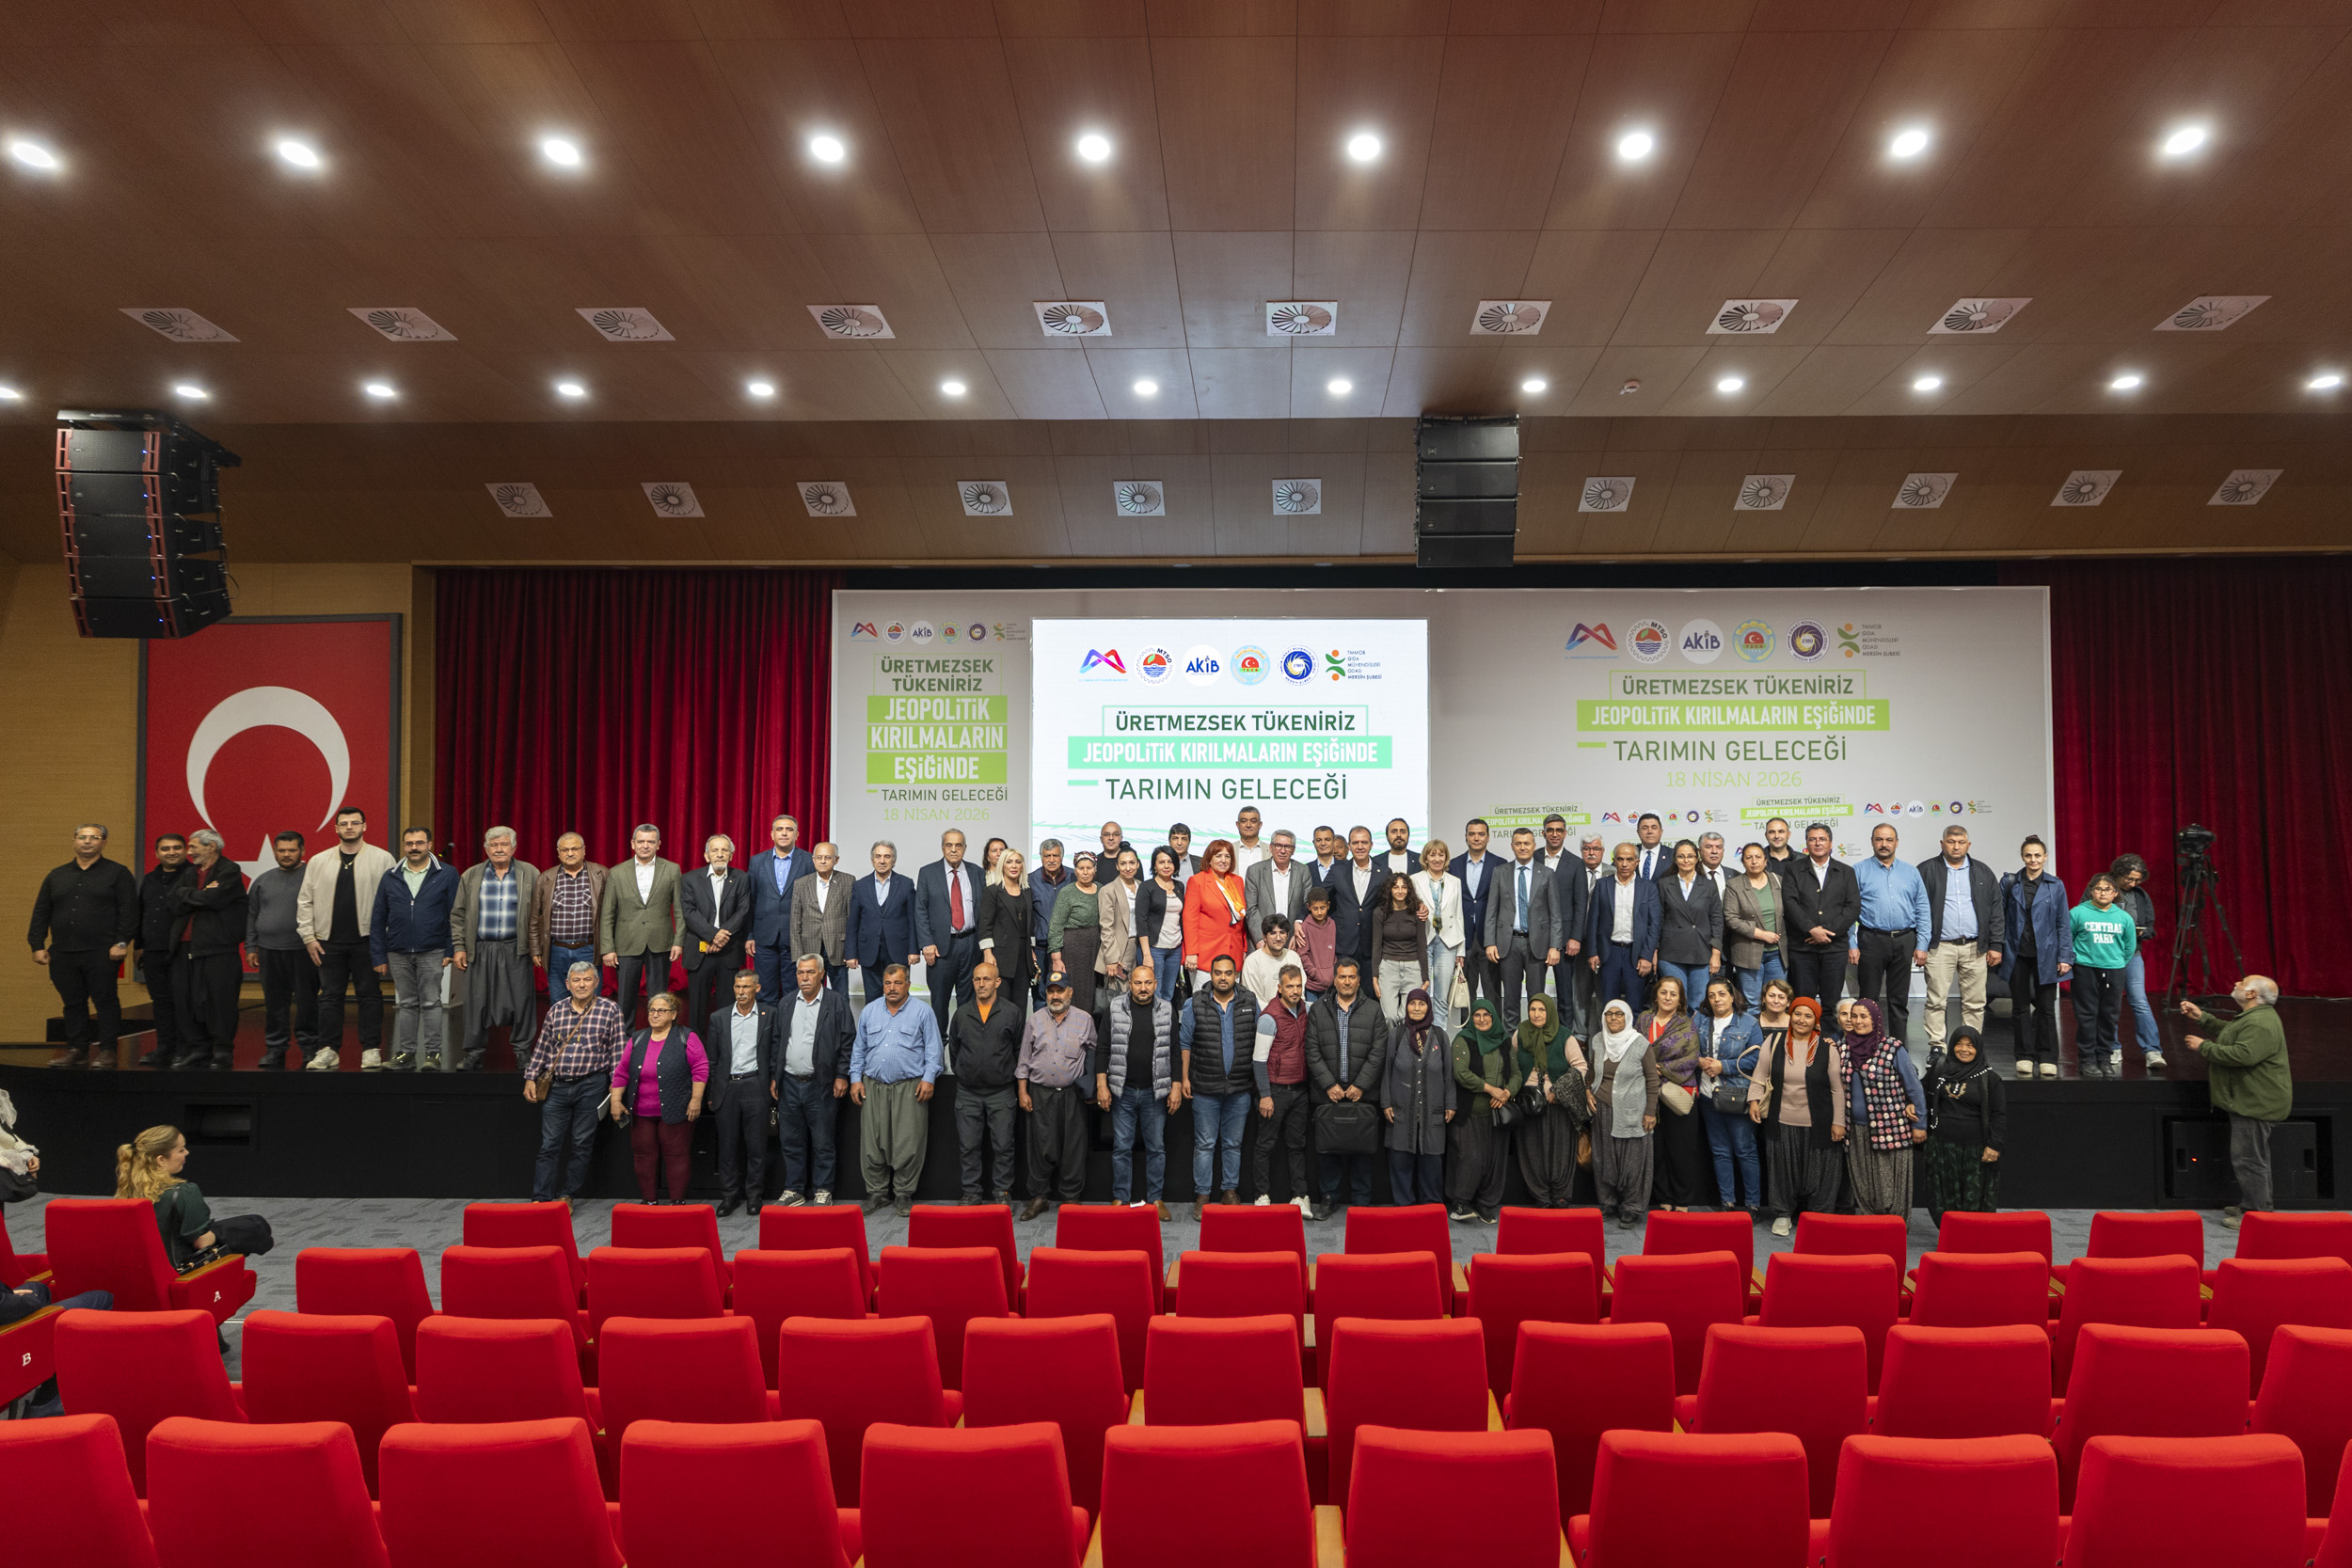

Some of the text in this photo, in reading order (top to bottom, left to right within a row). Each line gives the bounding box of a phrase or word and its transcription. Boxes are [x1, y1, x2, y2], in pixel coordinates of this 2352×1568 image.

[1650, 621, 1668, 640] MTSO
[1682, 631, 1721, 650] AKİB
[1156, 648, 1172, 663] MTSO
[881, 656, 994, 673] ÜRETMEZSEK
[1185, 657, 1220, 673] AKİB
[892, 674, 982, 692] TÜKENİRİZ
[1622, 674, 1854, 695] ÜRETMEZSEK TÜKENİRİZ
[1116, 710, 1356, 731] ÜRETMEZSEK TÜKENİRİZ
[1685, 705, 1798, 725] KIRILMALARIN
[871, 726, 1004, 749] KIRILMALARIN
[1181, 742, 1297, 763] KIRILMALARIN
[1613, 735, 1847, 761] TARIMIN GELECEĞİ
[1666, 768, 1803, 787] 18 NİSAN 2026
[882, 786, 1009, 801] TARIMIN GELECEĞİ
[1105, 772, 1347, 800] TARIMIN GELECEĞİ
[1756, 796, 1840, 806] ÜRETMEZSEK TÜKENİRİZ
[883, 805, 990, 821] 18 NİSAN 2026
[1494, 804, 1578, 815] ÜRETMEZSEK TÜKENİRİZ
[1780, 808, 1821, 816] KIRILMALARIN
[1518, 816, 1543, 825] KIRILMA
[2084, 922, 2123, 934] CENTRAL
[2093, 933, 2115, 944] PARK
[214, 1291, 222, 1303] A
[22, 1352, 32, 1367] B
